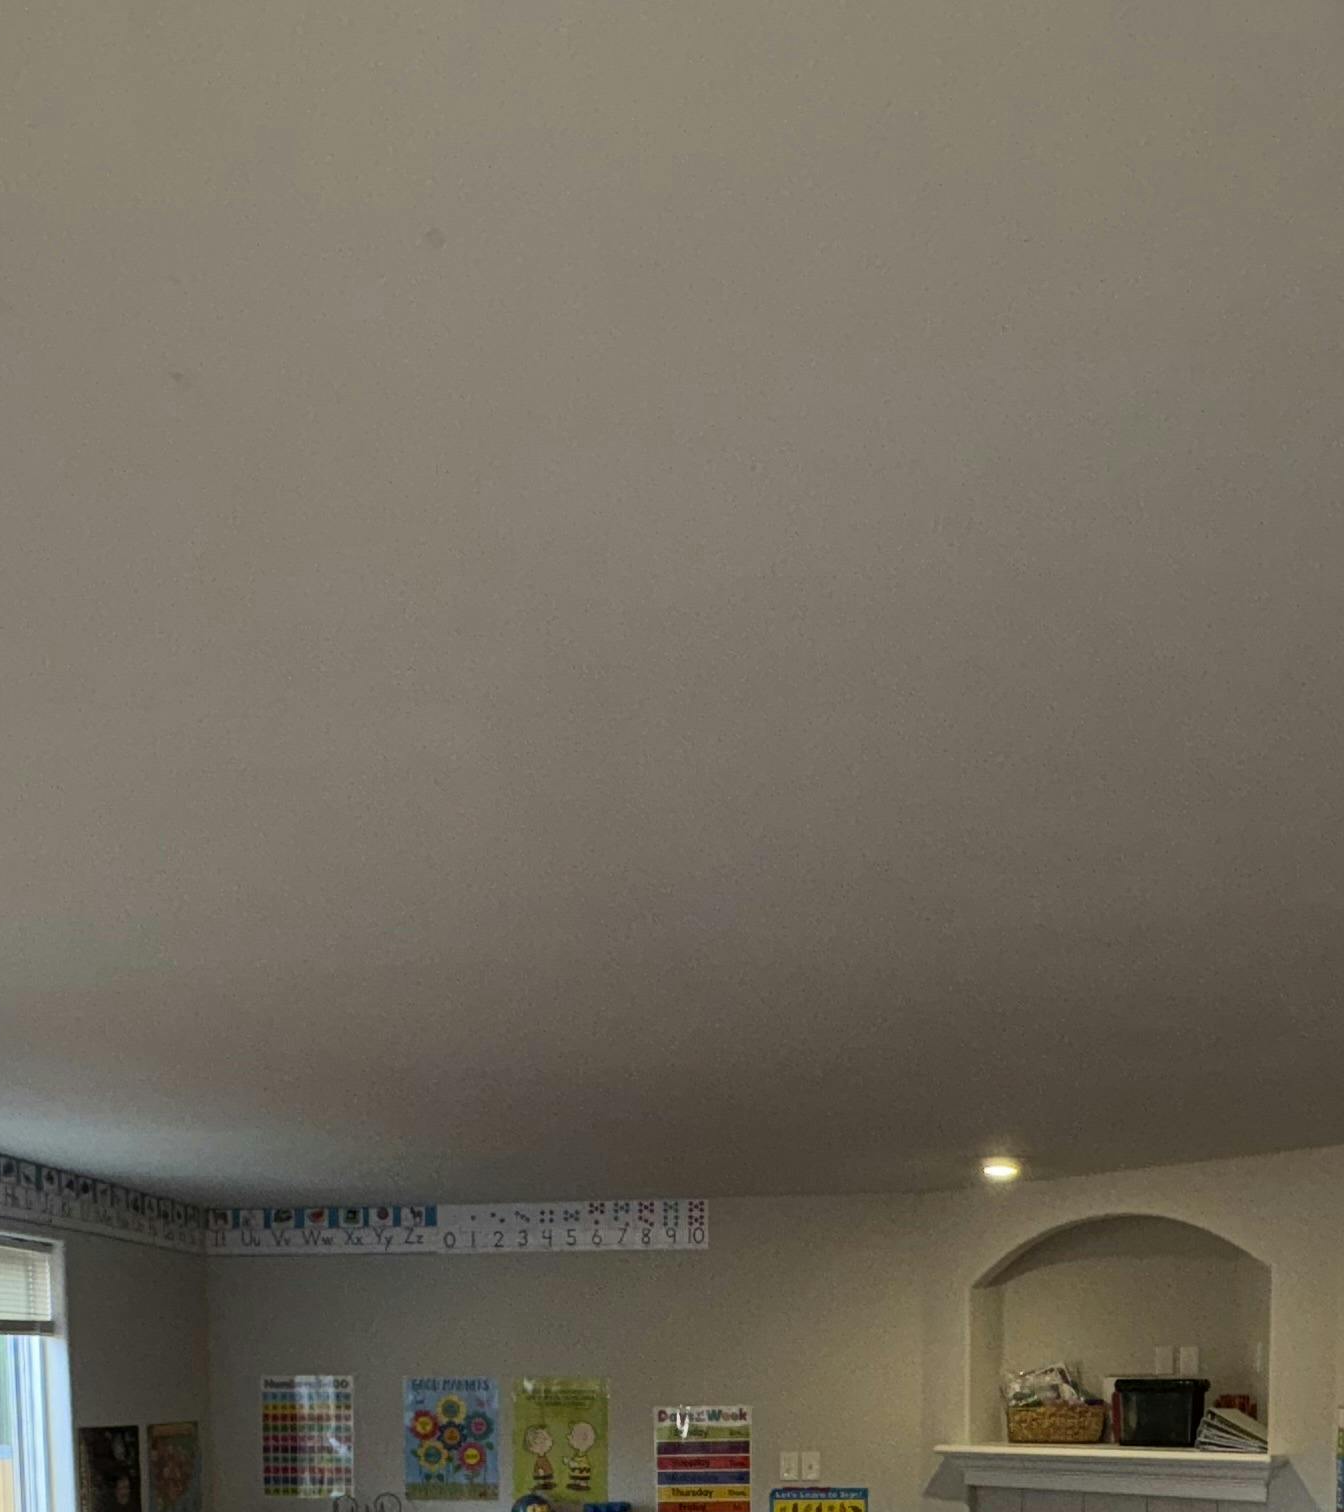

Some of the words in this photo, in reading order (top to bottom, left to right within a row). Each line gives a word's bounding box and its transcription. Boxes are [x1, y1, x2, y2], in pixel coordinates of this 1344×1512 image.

[240, 1230, 261, 1247] Uu
[272, 1230, 291, 1247] Vv
[301, 1229, 334, 1246] Ww
[345, 1229, 364, 1246] Xx
[371, 1226, 393, 1251] Yy
[403, 1227, 424, 1245] Zz
[444, 1231, 456, 1248] 0
[470, 1231, 476, 1248] 1
[493, 1231, 505, 1248] 2
[518, 1230, 528, 1247] 3
[541, 1228, 552, 1247] 4
[565, 1229, 577, 1246] 5
[592, 1228, 603, 1245] 6
[616, 1228, 628, 1245] 7
[641, 1228, 651, 1245] 8
[666, 1227, 677, 1244] 9
[688, 1227, 705, 1244] 10
[707, 1408, 747, 1422] Week
[671, 1488, 713, 1498] Thursday
